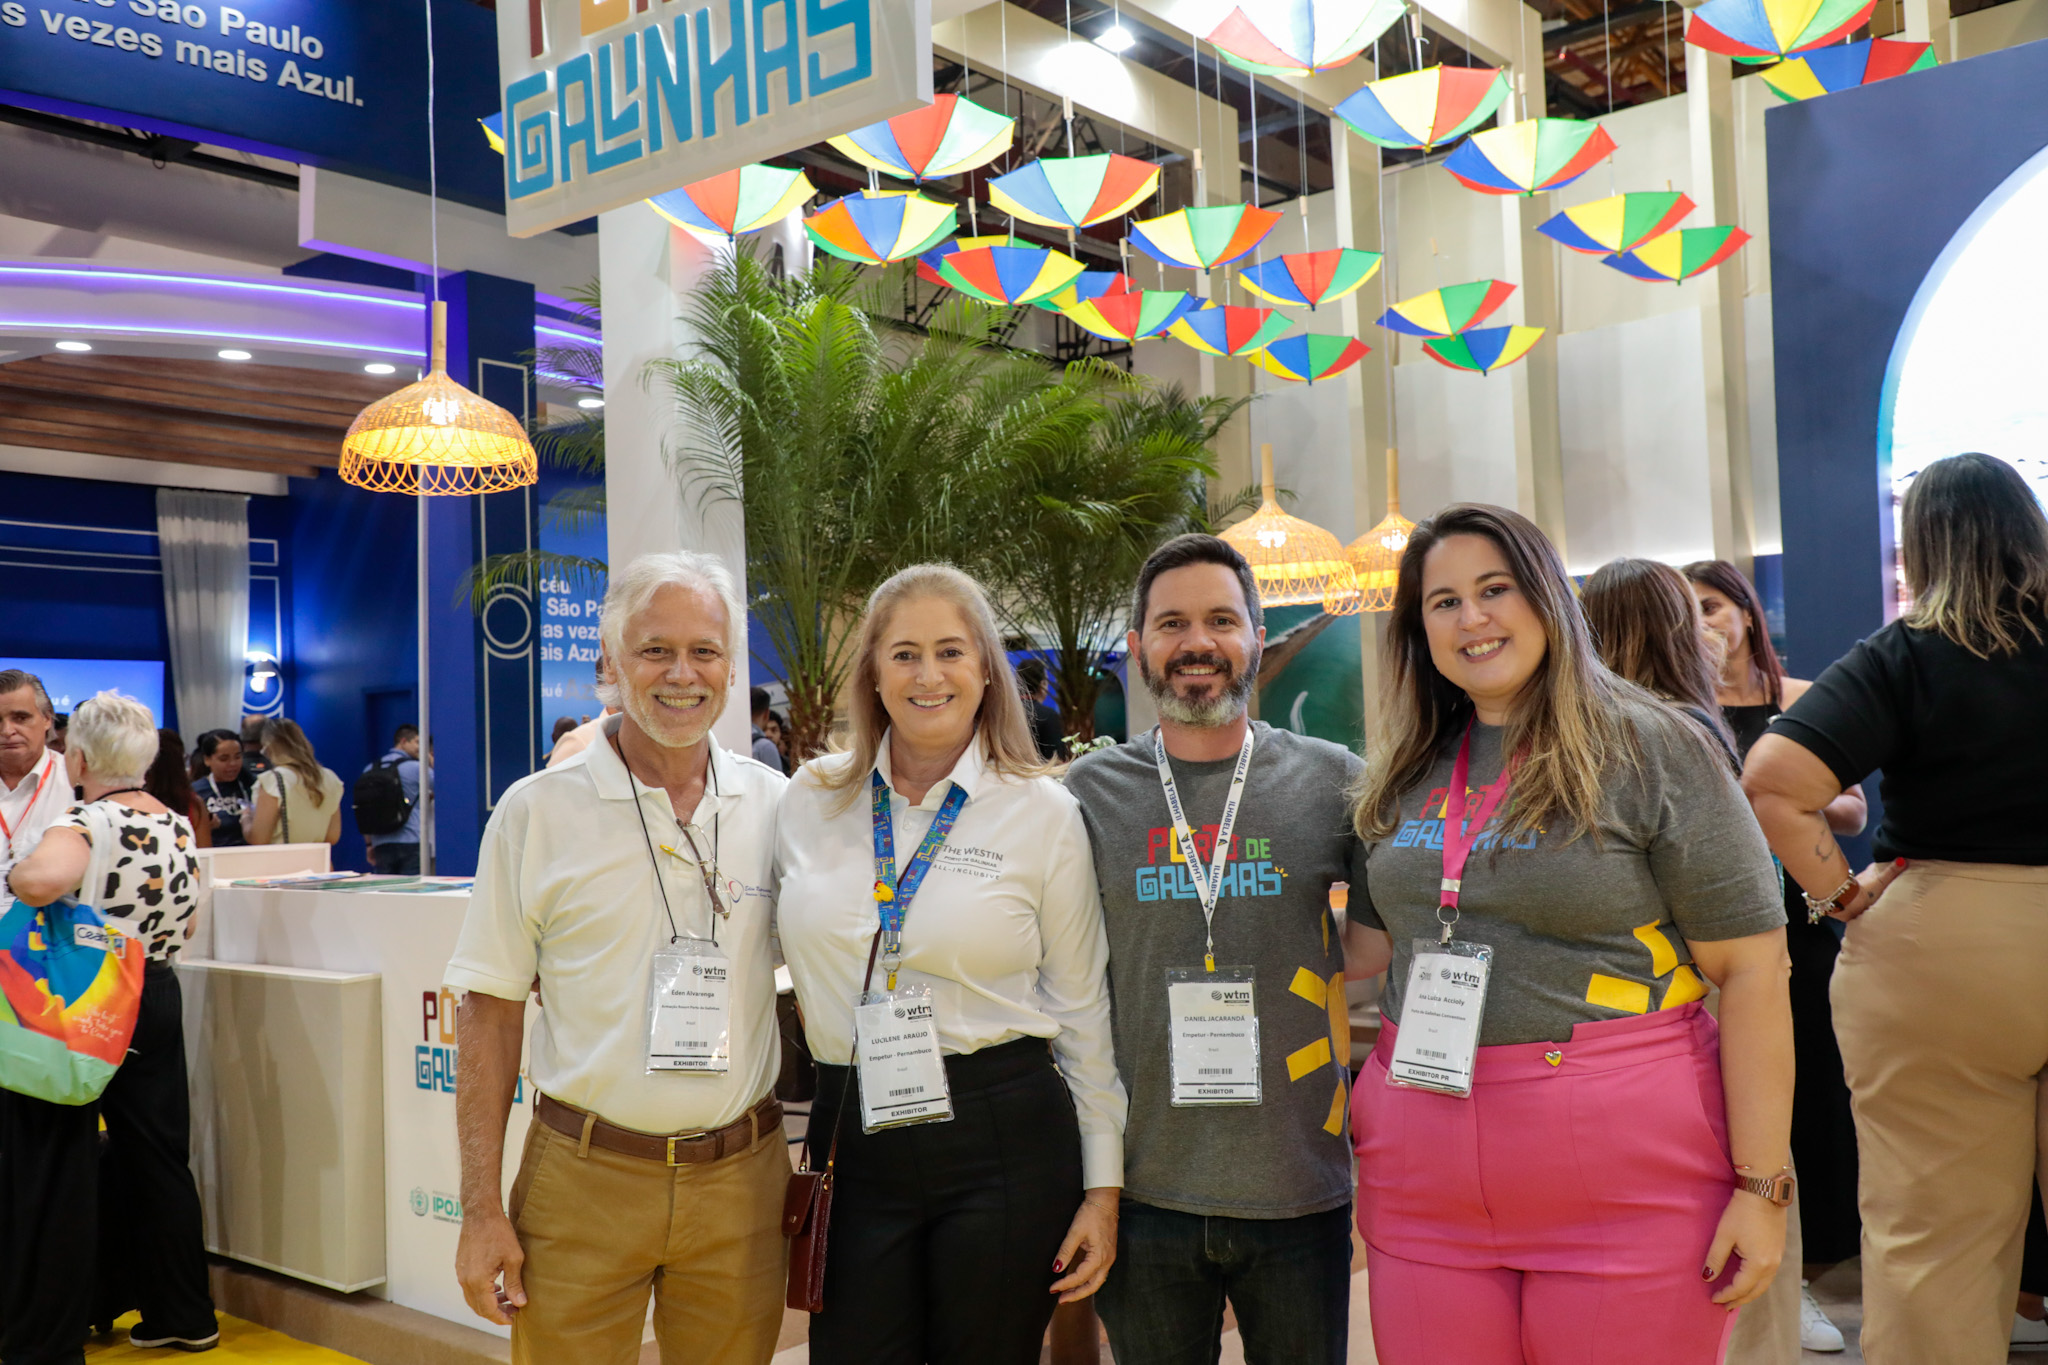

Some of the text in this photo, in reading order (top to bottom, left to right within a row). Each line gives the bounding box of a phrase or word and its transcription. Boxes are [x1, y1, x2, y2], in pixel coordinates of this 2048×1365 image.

[220, 6, 324, 60] Paulo
[40, 9, 163, 57] vezes
[176, 39, 268, 82] mais
[277, 60, 364, 107] Azul.
[546, 597, 581, 617] São
[540, 643, 600, 662] ais Azu
[1236, 742, 1251, 775] ILHABELA
[1169, 787, 1182, 821] ILHABELA
[1220, 800, 1236, 836] ILHABELA
[943, 845, 1003, 861] THE WESTIN
[1245, 838, 1271, 860] DE
[1185, 844, 1203, 881] ILHABELA
[933, 864, 1000, 880] ALL-INCLUSIVE
[1209, 865, 1221, 905] ILHABELA
[704, 966, 726, 976] wtm
[1454, 971, 1480, 983] wtm
[1224, 990, 1250, 999] wtm
[1443, 997, 1465, 1006] Accioly
[907, 1005, 931, 1015] wtm
[871, 1035, 900, 1045] LUCILENE
[869, 1054, 893, 1062] Empetur
[897, 1048, 932, 1057] Pernambuco
[1408, 1068, 1439, 1079] EXHIBITOR
[891, 1106, 928, 1117] EXHIBITOR
[432, 1196, 464, 1218] IPOJ
